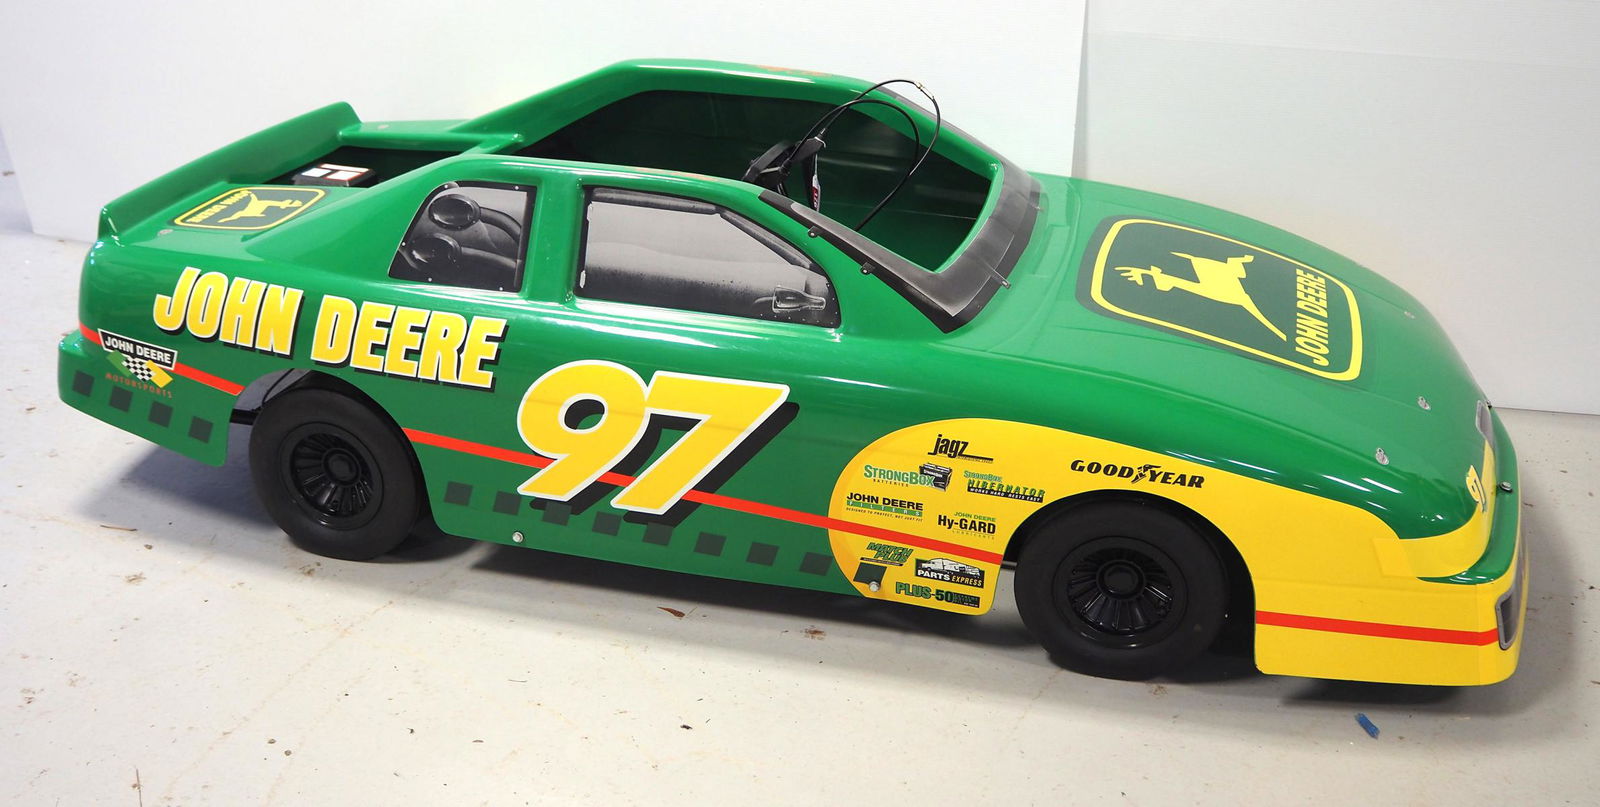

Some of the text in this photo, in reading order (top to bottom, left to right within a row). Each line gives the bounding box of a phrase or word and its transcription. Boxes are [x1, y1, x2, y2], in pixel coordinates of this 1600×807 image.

[153, 266, 508, 390] JOHN DEERE
[1295, 268, 1329, 367] JOHN DEERE
[104, 336, 172, 365] JOHN DEERE
[105, 372, 173, 399] MOTORSPORTS
[517, 359, 792, 517] 97
[927, 434, 993, 461] jagz
[1070, 459, 1205, 489] GOODYEAR
[968, 479, 1046, 498] HIBERNATOR
[846, 492, 924, 511] JOHN DEERE
[848, 501, 921, 516] FILTERS
[938, 514, 996, 535] Hy-GARD
[954, 511, 996, 522] JOHN DEERE
[866, 542, 914, 558] MATCH
[873, 549, 909, 563] PLUS
[917, 569, 982, 587] PARTS EXPRESS
[896, 581, 954, 602] PLUS-50
